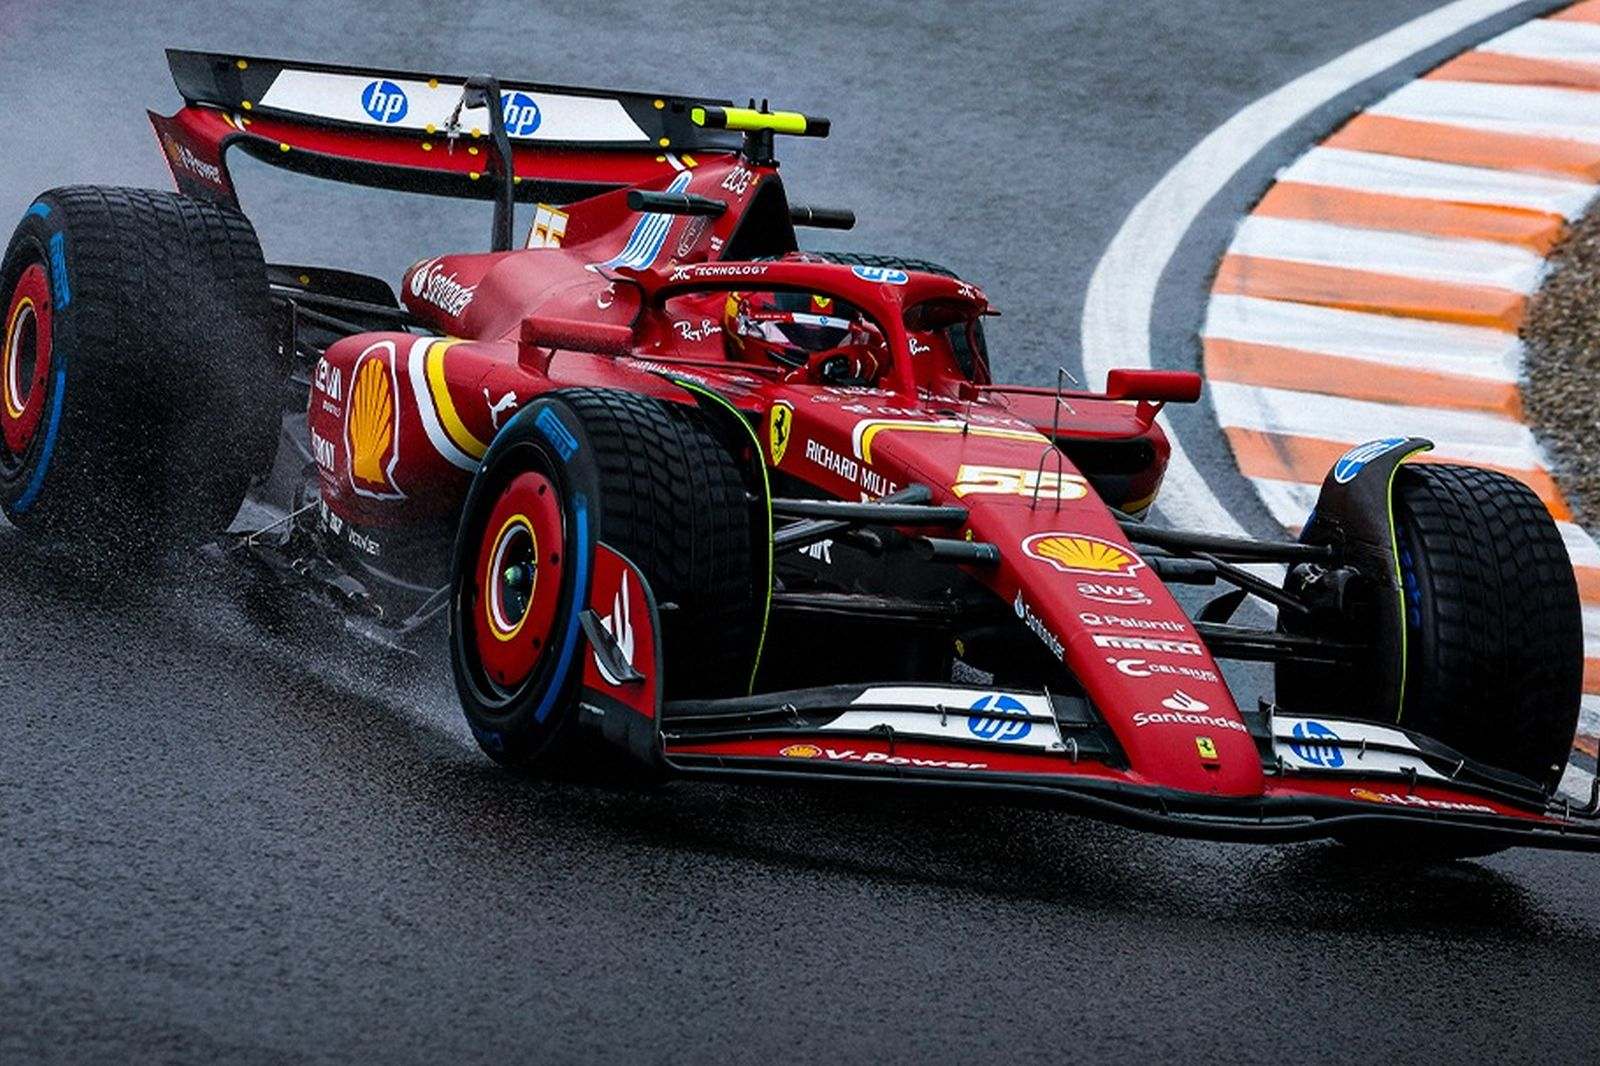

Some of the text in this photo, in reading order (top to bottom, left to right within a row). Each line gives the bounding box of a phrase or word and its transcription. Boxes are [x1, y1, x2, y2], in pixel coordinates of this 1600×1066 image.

[366, 81, 404, 123] hp
[501, 93, 537, 135] hp
[805, 439, 858, 483] RICHARD
[951, 464, 1088, 500] 55
[1076, 582, 1148, 600] aws
[1106, 615, 1186, 632] Palantir
[975, 695, 1027, 741] hp
[1133, 711, 1248, 733] Santander
[824, 749, 988, 769] V-Power
[1299, 722, 1342, 768] hp
